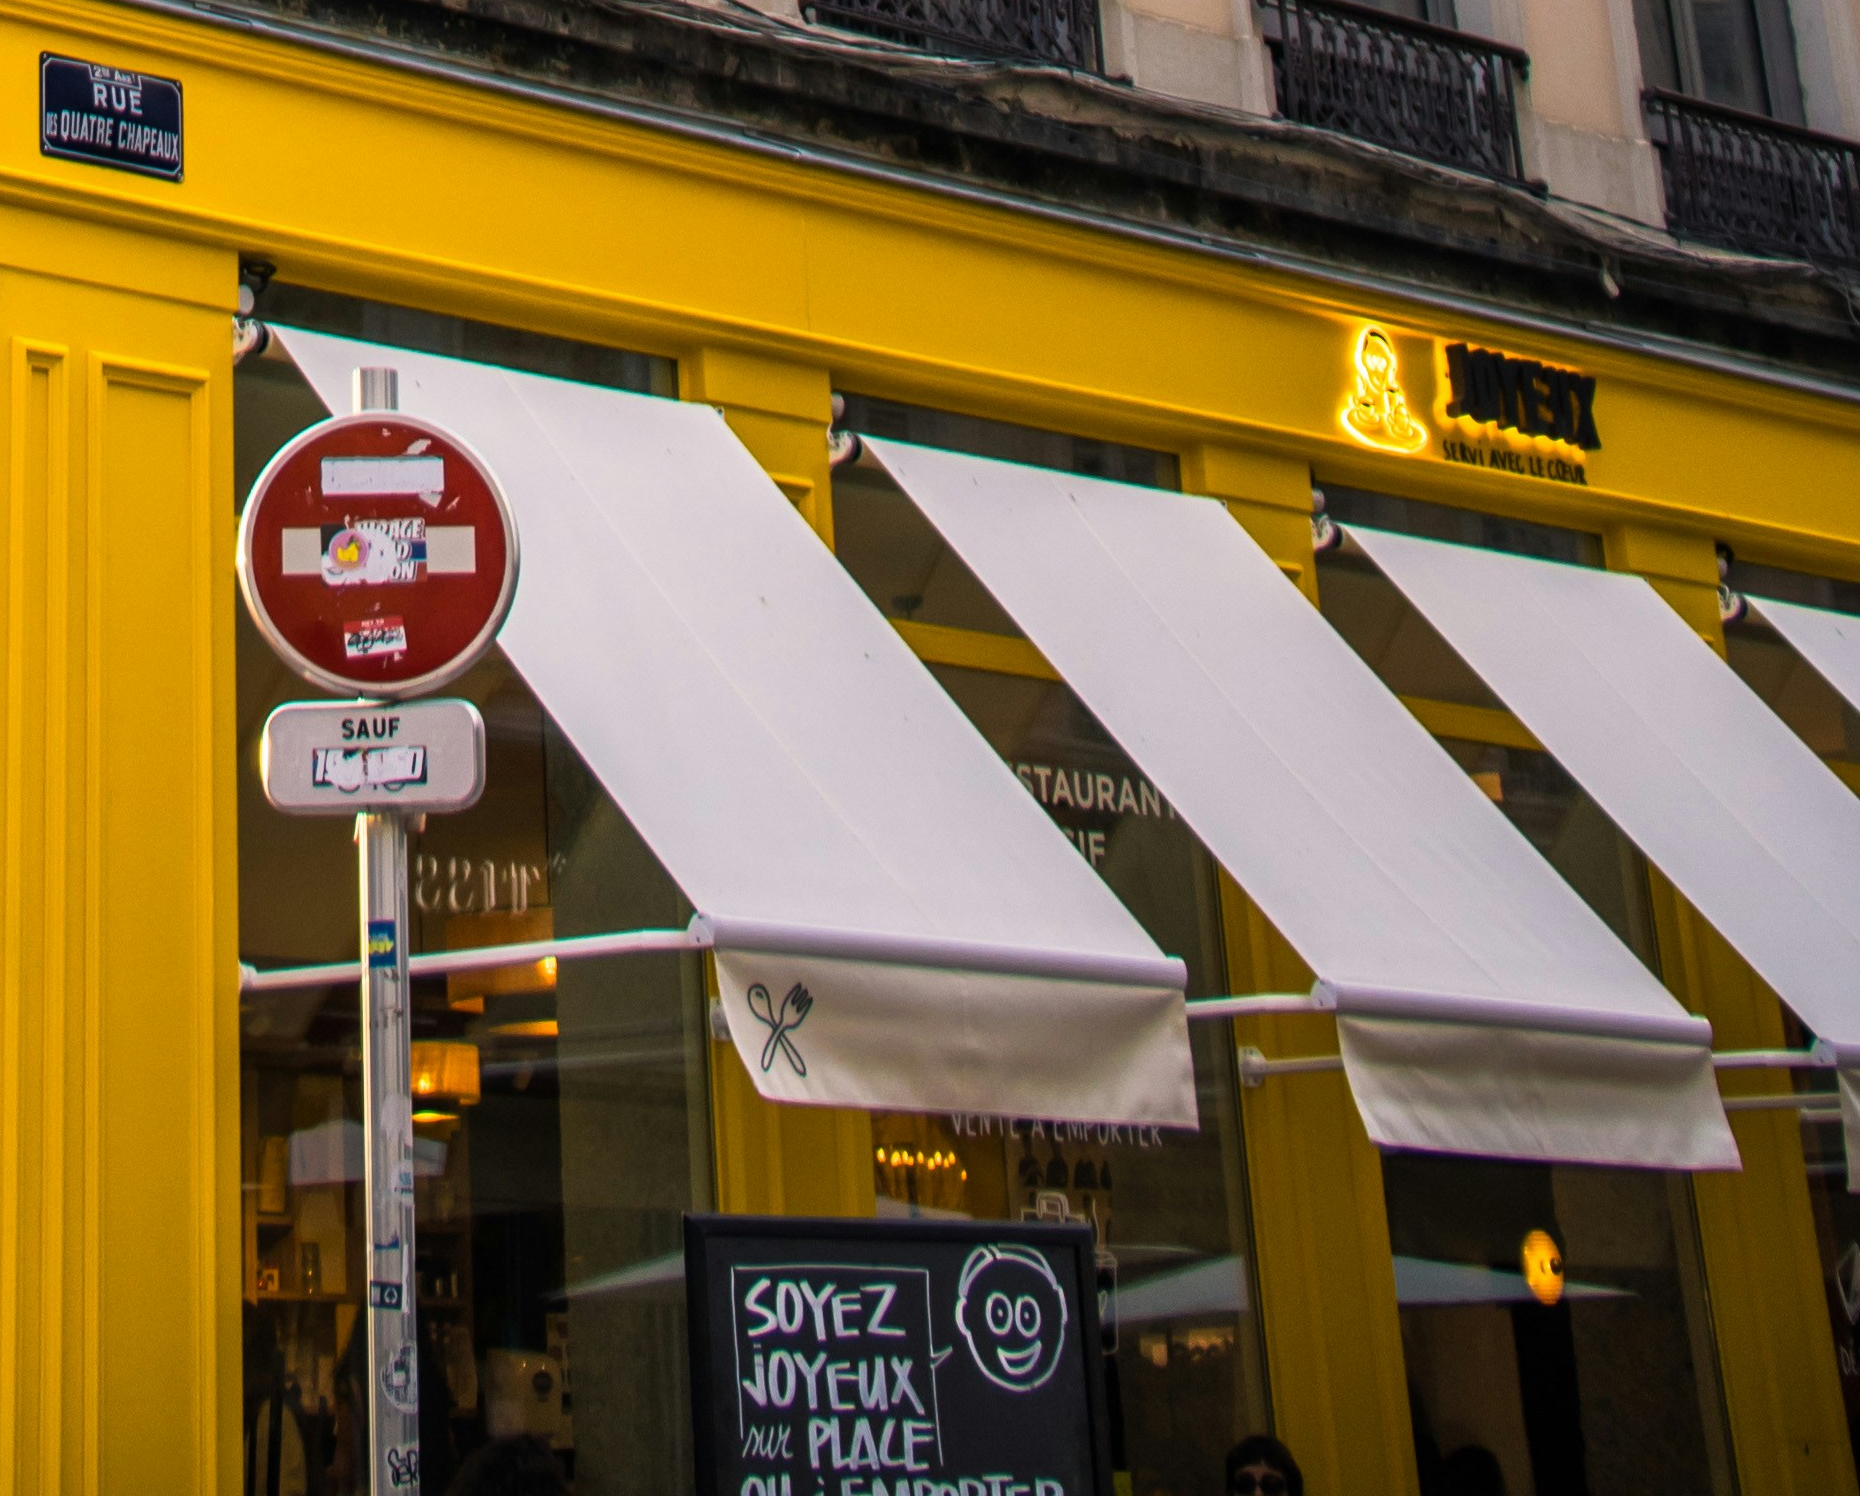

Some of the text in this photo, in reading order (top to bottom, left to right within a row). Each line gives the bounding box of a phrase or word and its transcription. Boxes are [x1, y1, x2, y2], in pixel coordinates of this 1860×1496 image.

[93, 82, 143, 115] RUE
[46, 109, 179, 161] DES QUATRE CHAPEAUX
[1445, 343, 1602, 450] JOYEUX
[1489, 448, 1525, 475] AVEC
[1528, 455, 1544, 477] LE
[341, 717, 400, 740] SAUF
[744, 1277, 907, 1342] SOYEZ
[742, 1416, 935, 1472] sur PLACE
